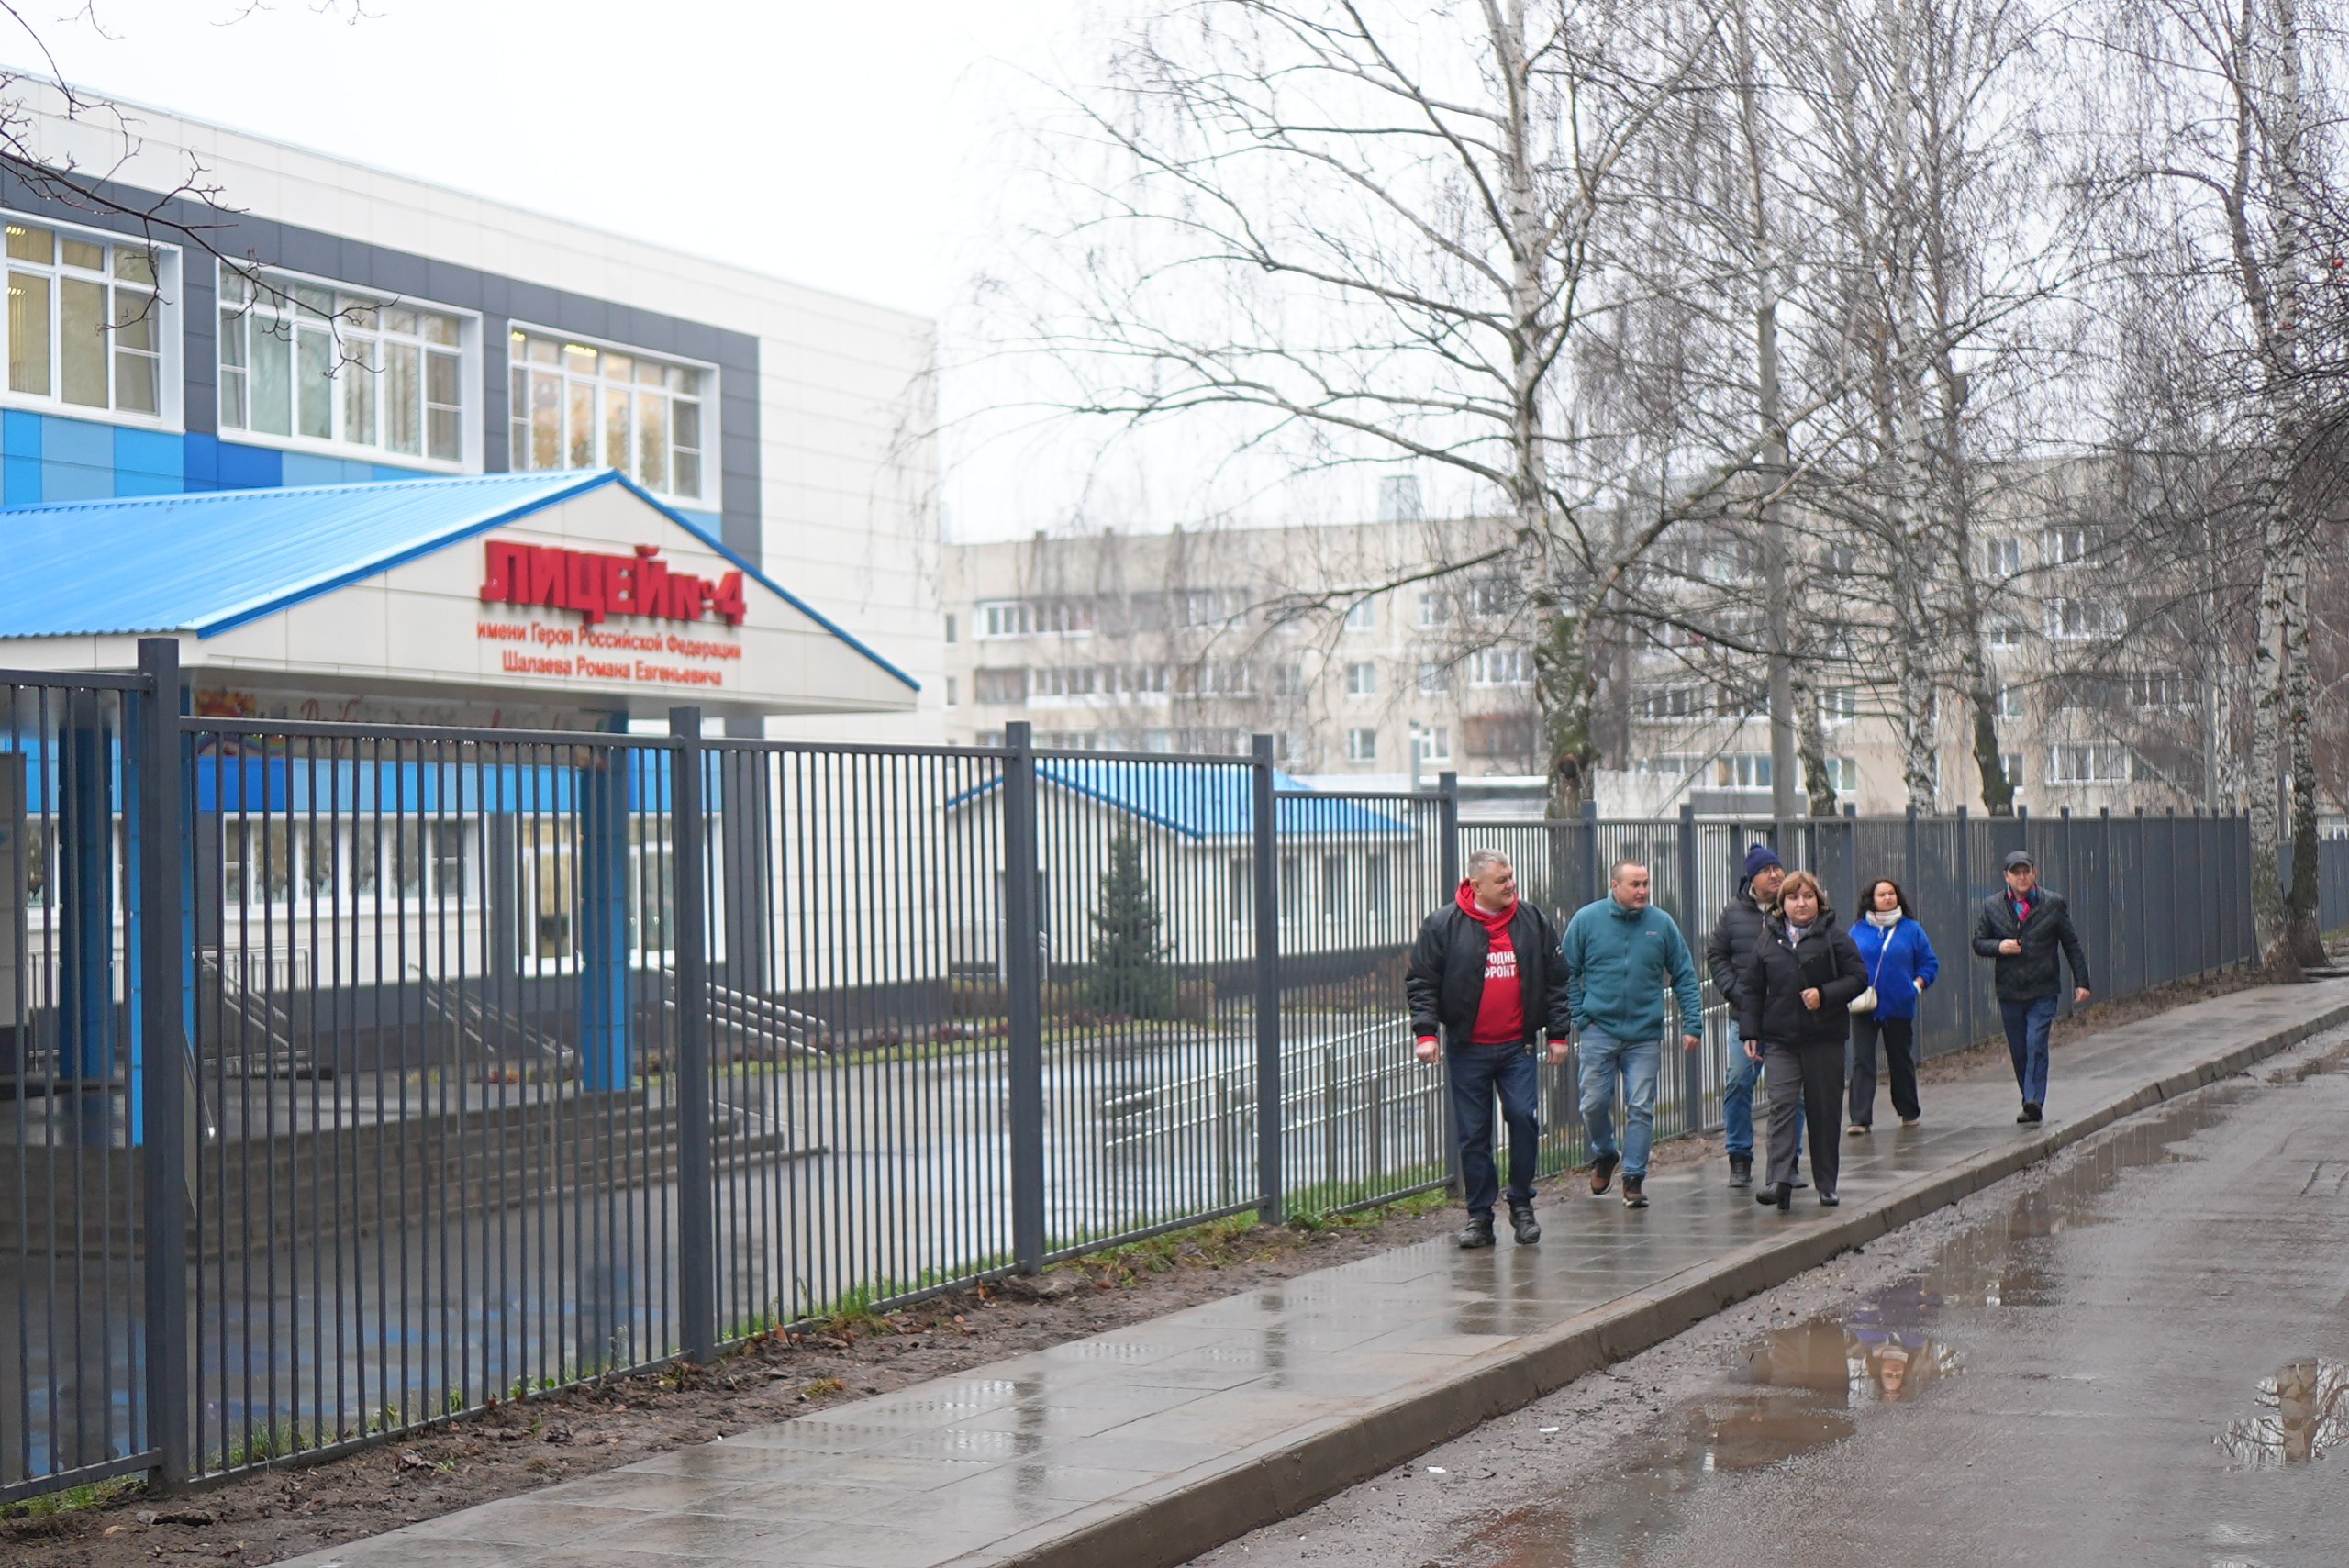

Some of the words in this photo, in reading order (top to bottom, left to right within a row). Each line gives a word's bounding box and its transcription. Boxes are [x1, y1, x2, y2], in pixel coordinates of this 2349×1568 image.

[480, 539, 668, 624] ЛИЦЕЙ
[668, 570, 746, 626] №4
[476, 621, 526, 641] имени
[530, 620, 573, 649] Героя
[578, 623, 662, 652] Российской
[667, 632, 741, 662] Федерации
[502, 649, 573, 675] Шалаева
[576, 654, 630, 678] Романа
[635, 659, 722, 686] Евгеньевича
